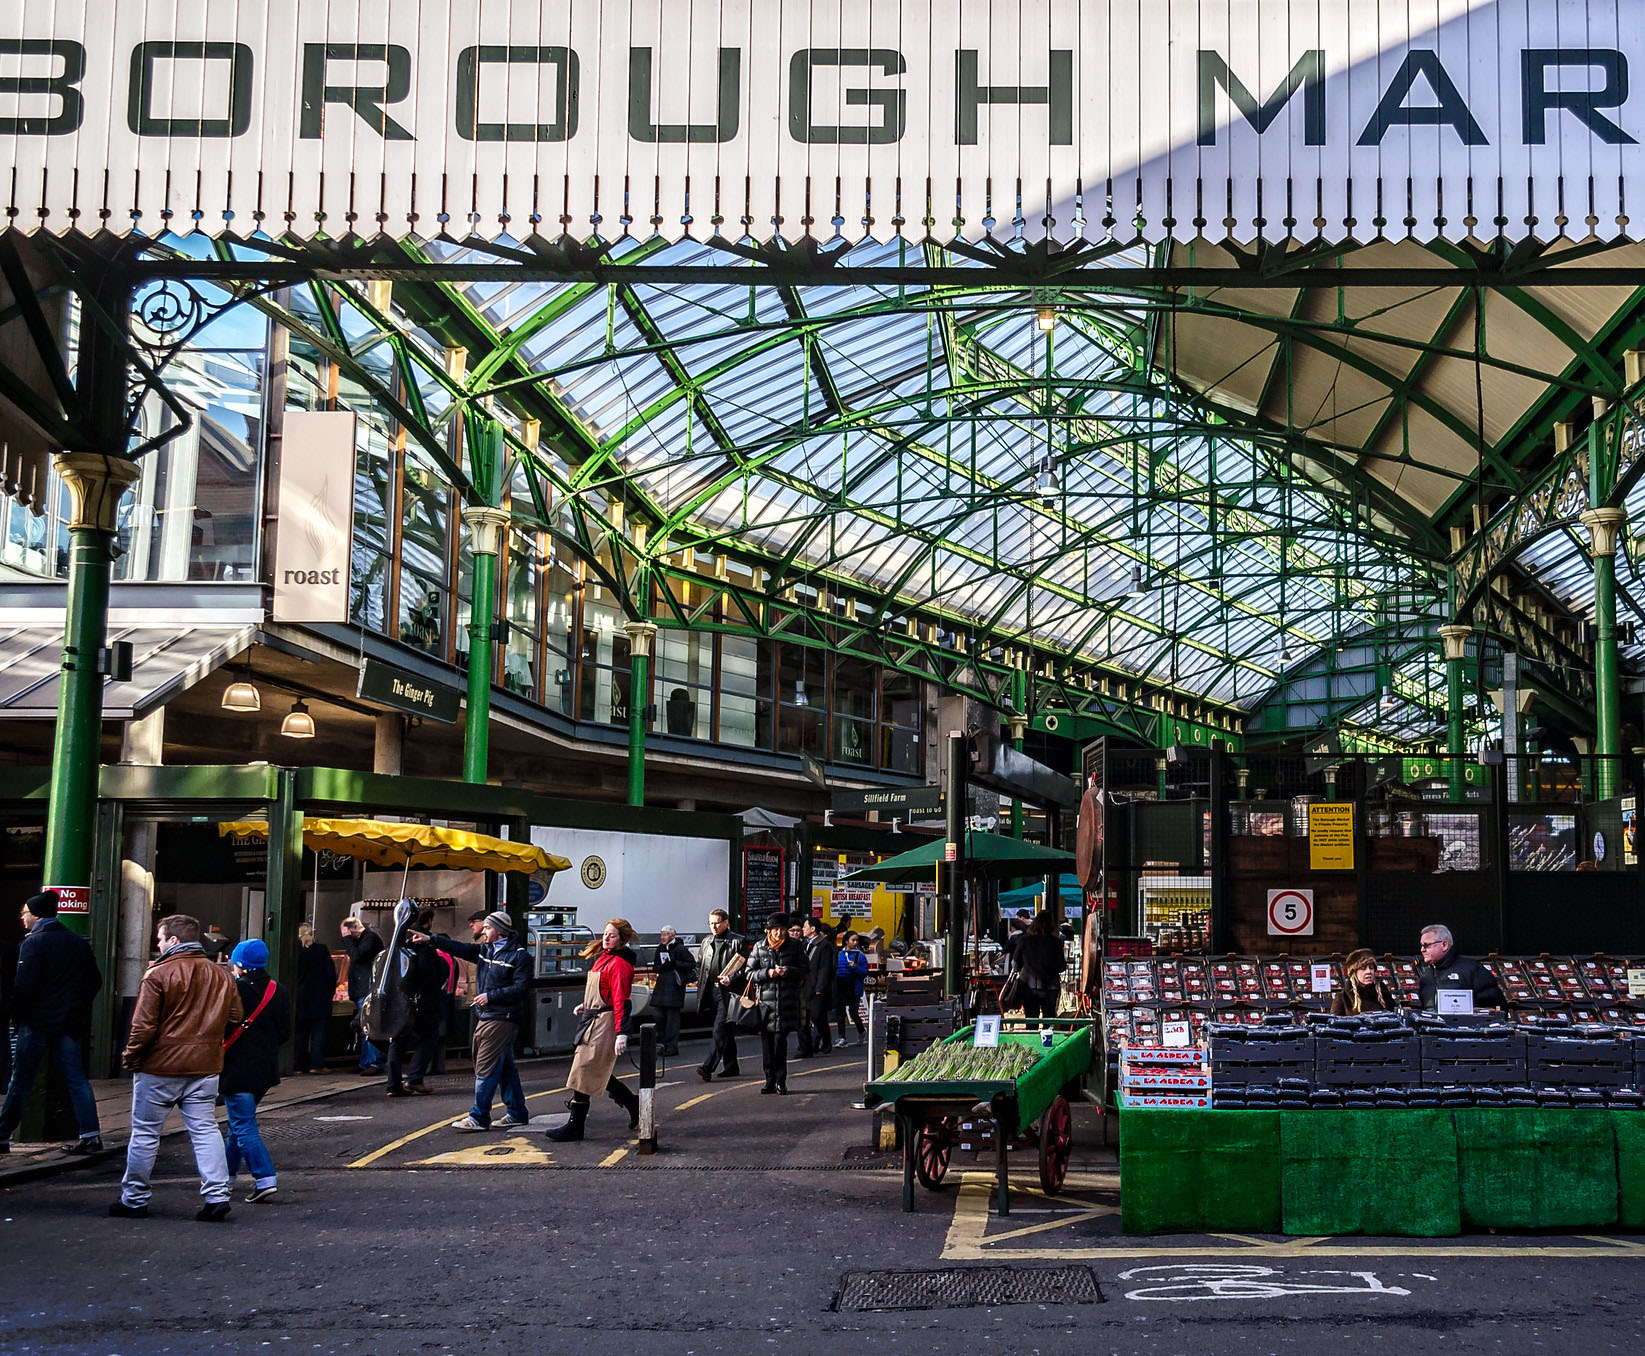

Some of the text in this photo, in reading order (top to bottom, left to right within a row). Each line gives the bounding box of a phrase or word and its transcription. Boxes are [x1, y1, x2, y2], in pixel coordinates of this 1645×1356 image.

[0, 38, 1640, 146] BOROUGH MAR
[284, 568, 340, 585] roast
[392, 679, 435, 708] The Ginger Pig
[841, 746, 862, 758] roast
[863, 793, 907, 803] Sillfield Farm
[847, 881, 875, 889] SAUSAGES
[60, 889, 77, 898] No
[57, 900, 87, 910] oking
[1285, 904, 1297, 921] 5
